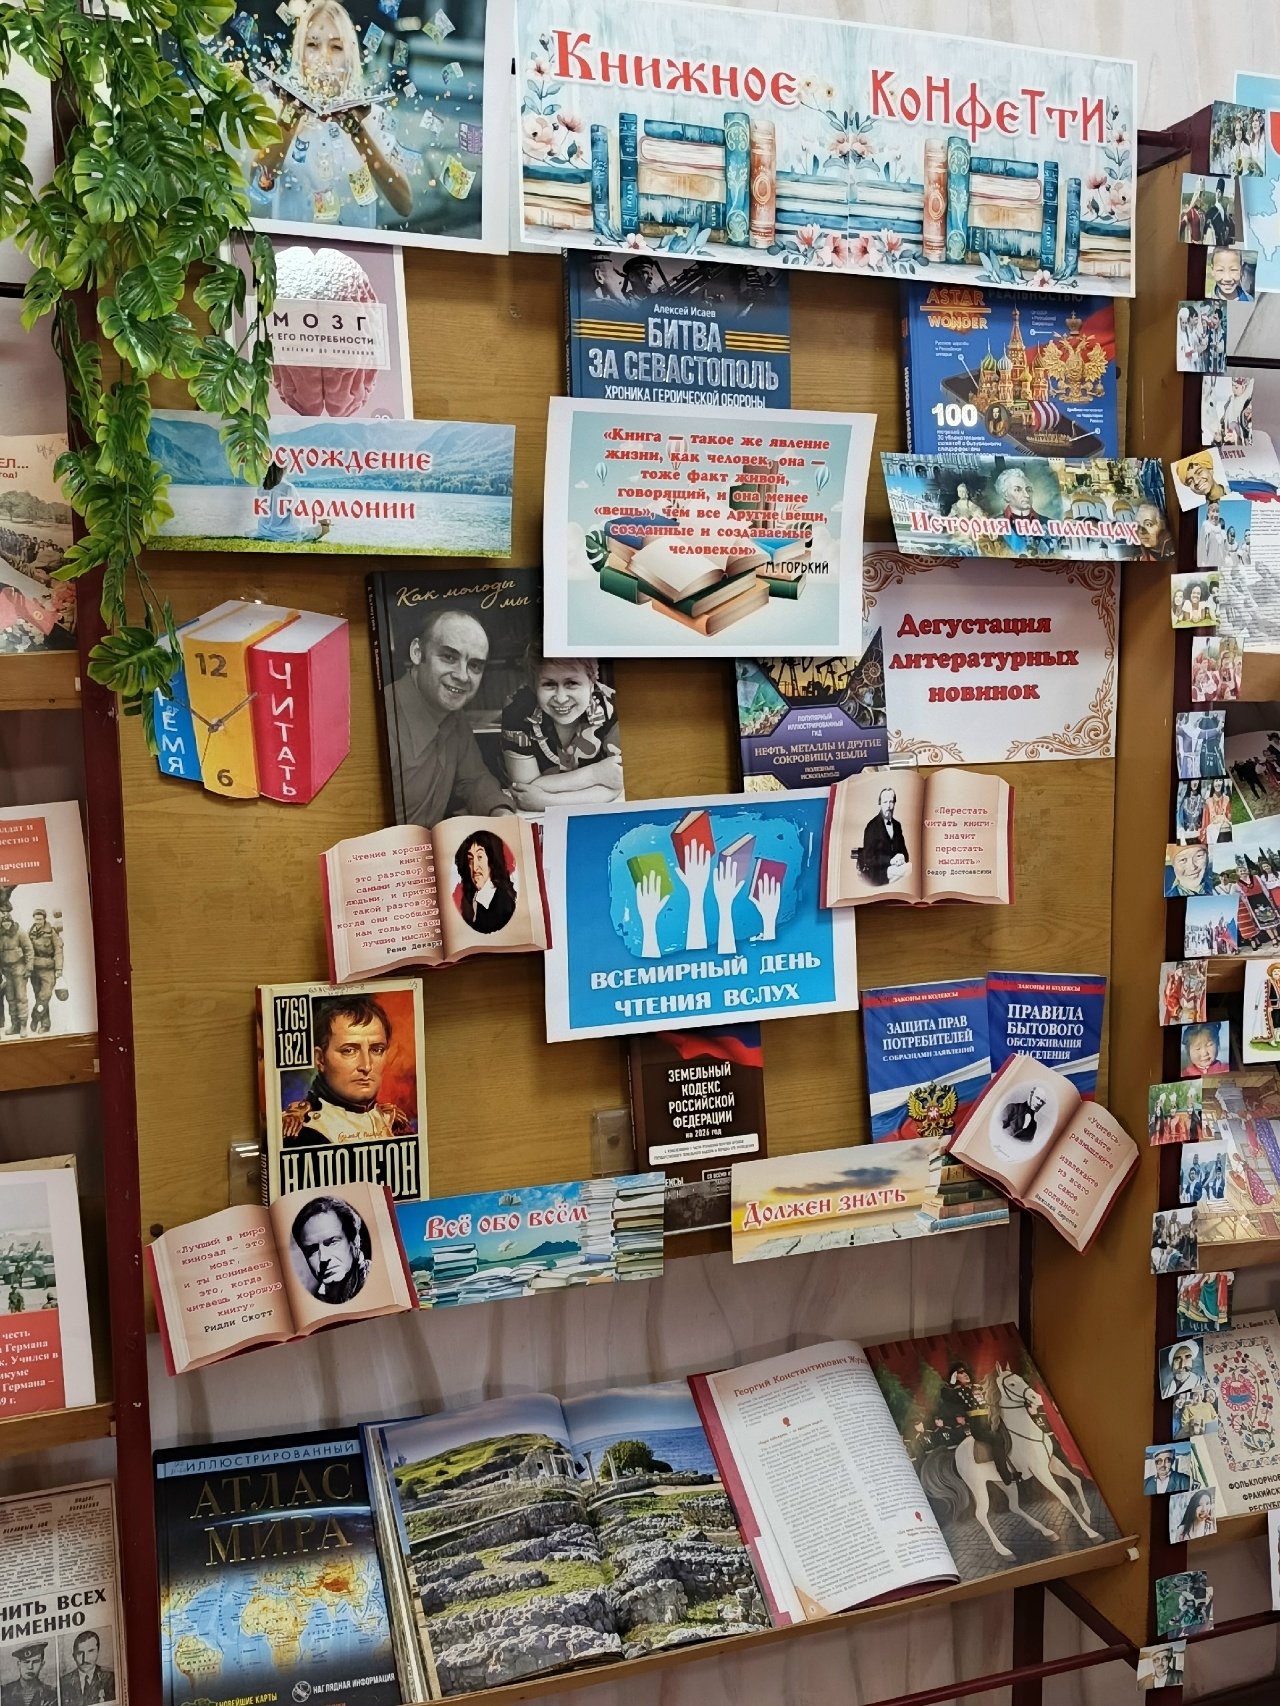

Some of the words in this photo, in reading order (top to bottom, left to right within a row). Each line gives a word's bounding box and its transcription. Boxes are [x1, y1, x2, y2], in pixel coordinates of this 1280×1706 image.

[926, 289, 985, 306] ASTAR
[654, 304, 689, 316] Алексей
[691, 307, 716, 318] Исаев
[273, 312, 366, 330] МОЗГ
[928, 316, 988, 329] WONDER
[278, 333, 296, 341] ЕГО
[300, 334, 374, 345] ПОТРЕБНОСТИ
[648, 317, 722, 353] БИТВА
[589, 348, 619, 379] ЗА
[625, 351, 779, 391] СЕВАСТОПОЛЬ
[605, 385, 650, 400] ХРОНИКА
[653, 387, 719, 406] ГЕРОИЧЕСКОЙ
[722, 392, 766, 408] ОБОРОНЫ
[931, 403, 978, 427] 100
[603, 428, 662, 444] «Книга
[691, 435, 734, 446] такое
[741, 437, 762, 448] же
[769, 439, 830, 450] явление
[604, 450, 663, 463] жизни,
[670, 452, 700, 462] как
[706, 455, 773, 469] человек,
[779, 456, 805, 467] она
[640, 470, 680, 481] тоже
[687, 469, 727, 484] факт
[735, 472, 790, 486] живой,
[617, 487, 710, 502] говорящий,
[717, 492, 727, 501] и
[733, 492, 760, 502] она
[767, 493, 808, 503] менее
[254, 498, 268, 516] к
[279, 498, 415, 524] гармонии
[594, 506, 655, 518] «вещь»,
[662, 508, 691, 518] чем
[697, 509, 720, 519] все
[727, 509, 779, 522] другие
[785, 511, 828, 524] вещи,
[611, 525, 694, 537] созданные
[717, 527, 813, 539] создаваемые
[911, 511, 1010, 540] История
[1019, 519, 1042, 534] на
[1050, 519, 1140, 544] пальцах
[669, 544, 756, 556] человеком»
[781, 560, 829, 574] ГОРЬКИЙ
[397, 586, 439, 607] Как
[443, 580, 516, 609] молоды
[500, 596, 531, 608] мы
[897, 614, 1051, 637] Дегустация
[195, 653, 228, 678] 12
[889, 649, 1079, 673] литературных
[929, 684, 1040, 703] новинок
[268, 660, 298, 796] ЧИТАТЬ
[788, 720, 844, 730] ИЛЛЮСТРИРОВАННЫЙ
[791, 742, 836, 753] МЕТАЛЛЫ
[838, 741, 845, 749] И
[848, 739, 882, 749] ДРУГИЕ
[773, 752, 834, 765] СОКРОВИЩА
[836, 750, 867, 759] ЗЕМЛИ
[217, 769, 234, 787] 6
[392, 845, 432, 855] хороших
[400, 857, 421, 865] книг
[377, 868, 422, 881] разговор
[357, 883, 390, 893] самыми
[395, 876, 435, 887] лучшими
[346, 896, 384, 906] людьми,
[402, 888, 436, 898] притом
[353, 907, 381, 915] такой
[386, 899, 436, 912] разговор,
[337, 920, 365, 929] когда
[378, 925, 411, 933] только
[363, 938, 396, 947] лучшие
[411, 940, 442, 950] Декарт
[590, 956, 748, 990] ВСЕМИРНЫЙ
[759, 951, 821, 974] ДЕНЬ
[614, 992, 711, 1017] ЧТЕНИЯ
[724, 983, 800, 1008] ВСЛУХ
[893, 994, 920, 1003] ЗАКОНЫ
[928, 991, 959, 1000] КОДЕКСЫ
[276, 997, 308, 1032] 1769
[1007, 1004, 1084, 1020] ПРАВИЛА
[887, 1019, 936, 1035] ЗАЩИТА
[939, 1015, 967, 1028] ПРАВ
[1007, 1022, 1084, 1036] БЫТОВОГО
[278, 1032, 309, 1066] 1821
[883, 1031, 973, 1050] ПОТРЕБИТЕЛЕЙ
[1007, 1037, 1082, 1048] ОБСЛУЖИВАНИЯ
[888, 1050, 931, 1061] ОБРАЗЦАМИ
[933, 1046, 974, 1056] ЗАЯВЛЕНИЙ
[1018, 1050, 1071, 1060] НАСЕЛЕНИЯ
[668, 1062, 731, 1082] ЗЕМЕЛЬНЫЙ
[682, 1080, 721, 1096] КОДЕКС
[669, 1092, 735, 1114] РОССИЙСКОЙ
[673, 1111, 732, 1128] ФЕДЕРАЦИИ
[282, 1141, 418, 1197] НАПОЛЕОН
[744, 1199, 831, 1228] Должен
[839, 1190, 906, 1212] знать
[427, 1216, 471, 1239] Всё
[529, 1205, 588, 1226] всём
[176, 1238, 220, 1254] «Лучший
[239, 1228, 265, 1238] мире
[182, 1250, 226, 1265] кинозал
[210, 1259, 240, 1270] мозг,
[216, 1262, 273, 1280] понимаешь
[231, 1276, 262, 1288] когда
[187, 1298, 230, 1312] читаешь
[237, 1282, 282, 1299] хорошую
[218, 1303, 255, 1316] книгу»
[204, 1320, 236, 1332] Ридли
[242, 1310, 273, 1322] Скотт
[6, 1341, 48, 1353] Германа
[11, 1353, 49, 1365] Учился
[3, 1380, 46, 1392] Германа
[734, 1379, 771, 1397] Георгий
[773, 1358, 847, 1384] Константинович
[186, 1442, 354, 1472] ИЛЛЮСТРИРОВАННЫЙ
[190, 1463, 354, 1518] АТЛАС
[204, 1513, 353, 1566] МИРА
[57, 1588, 107, 1611] ВСЕХ
[1, 1611, 86, 1642] ИМЕННО
[313, 1680, 351, 1695] НАГЛЯДНАЯ
[352, 1673, 395, 1688] ИНФОРМАЦИЯ
[255, 1692, 278, 1705] КАРТЫ
